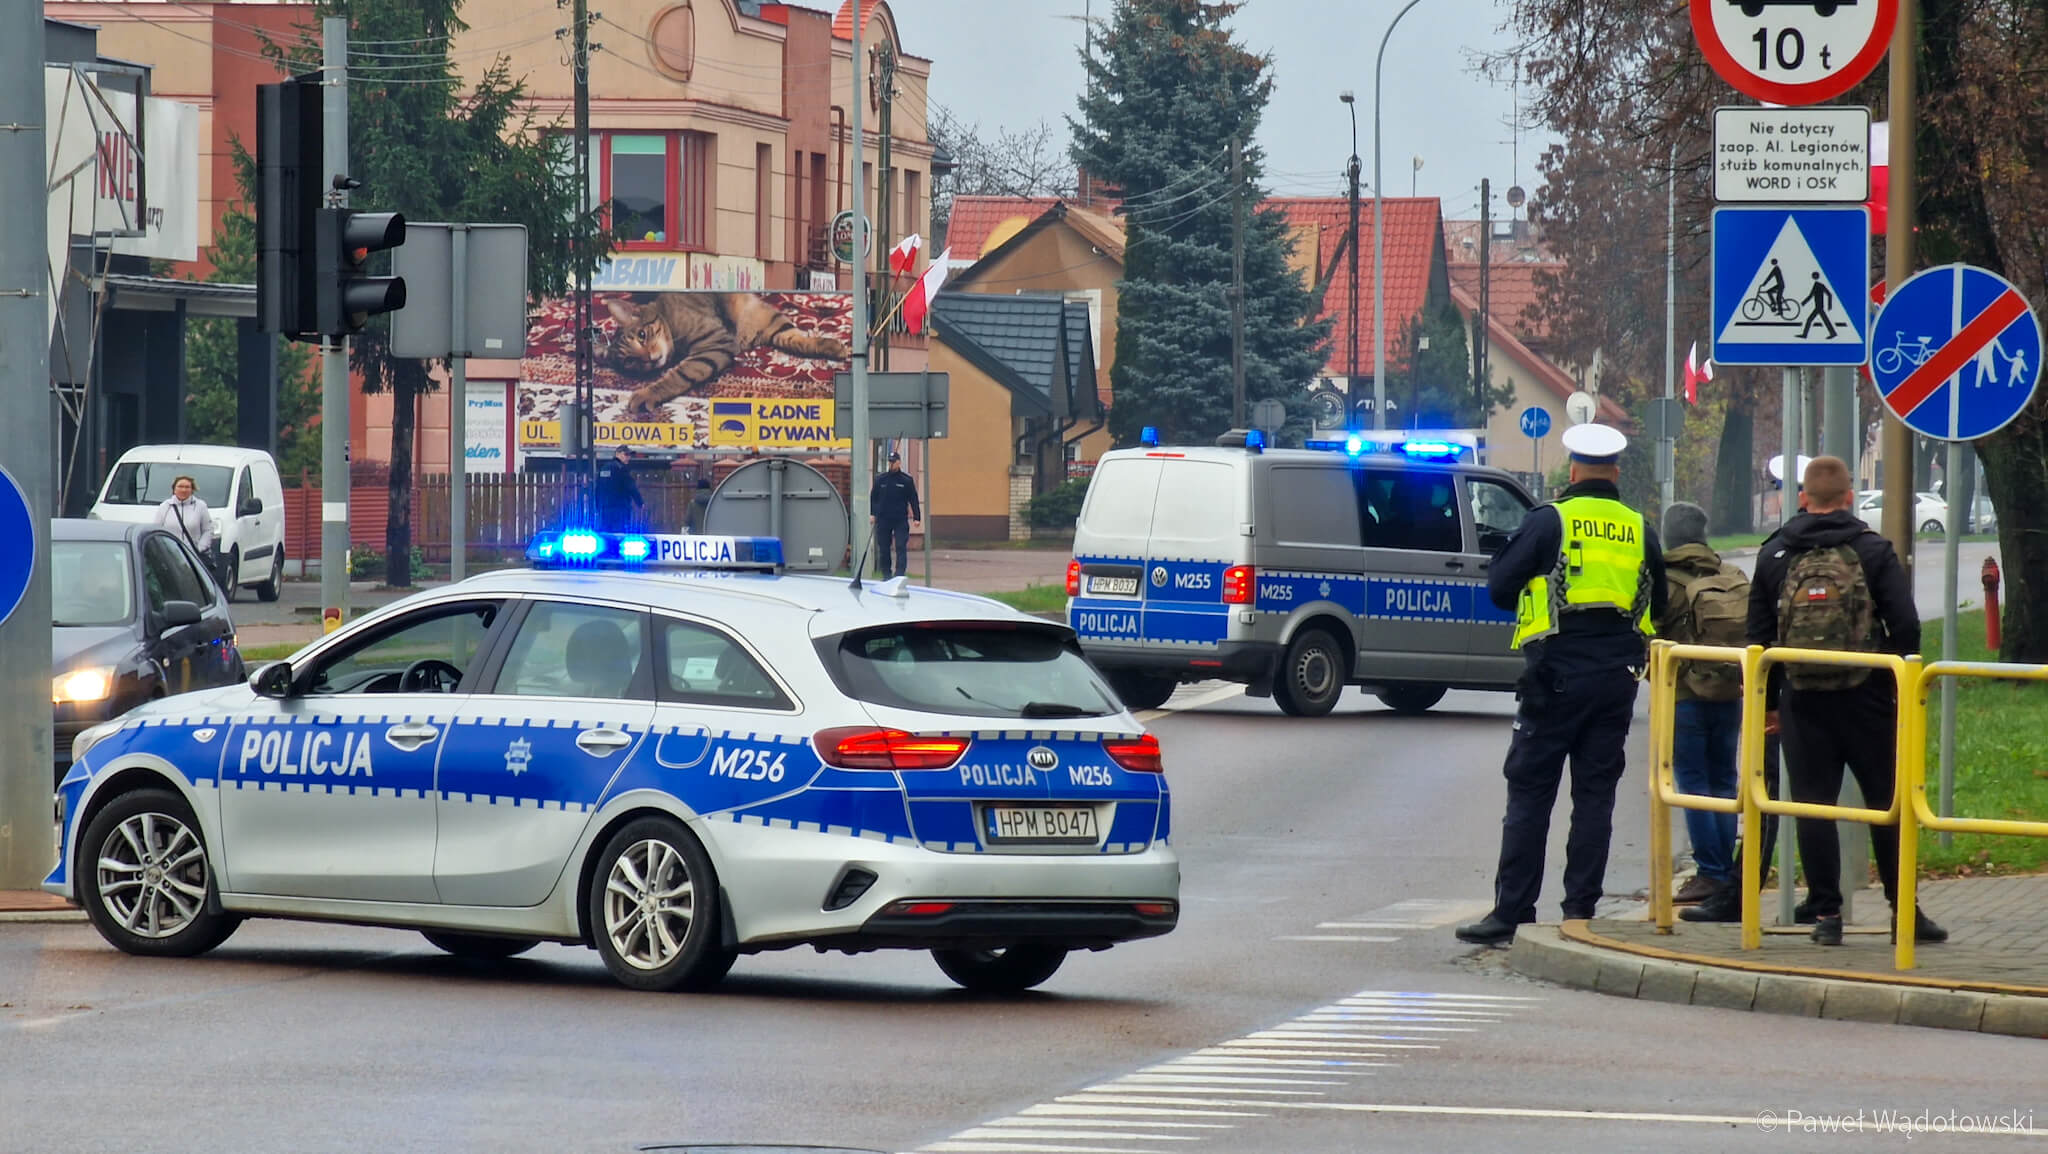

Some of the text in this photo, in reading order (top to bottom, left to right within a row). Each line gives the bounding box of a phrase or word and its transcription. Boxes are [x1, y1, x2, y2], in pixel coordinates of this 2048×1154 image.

[1752, 27, 1832, 71] 10 t
[1750, 121, 1835, 137] Nie dotyczy
[1719, 139, 1865, 156] zaop. Al. Legionów,
[1719, 158, 1864, 174] służb komunalnych,
[1746, 176, 1837, 189] WORD i OSK
[757, 404, 821, 420] ŁADNE
[526, 424, 554, 440] UL.
[669, 426, 688, 441] 15
[758, 426, 838, 442] DYWAN
[1572, 519, 1635, 545] POLICJA
[661, 540, 731, 561] POLICJA
[1175, 573, 1212, 590] M255
[1260, 583, 1293, 601] M255
[1386, 588, 1452, 612] POLICJA
[1079, 613, 1138, 633] POLICJA
[239, 730, 373, 777] POLICJA
[709, 746, 788, 782] M256
[959, 764, 1038, 786] POLICJA
[1068, 765, 1113, 787] M256
[1000, 811, 1091, 836] HPM B047
